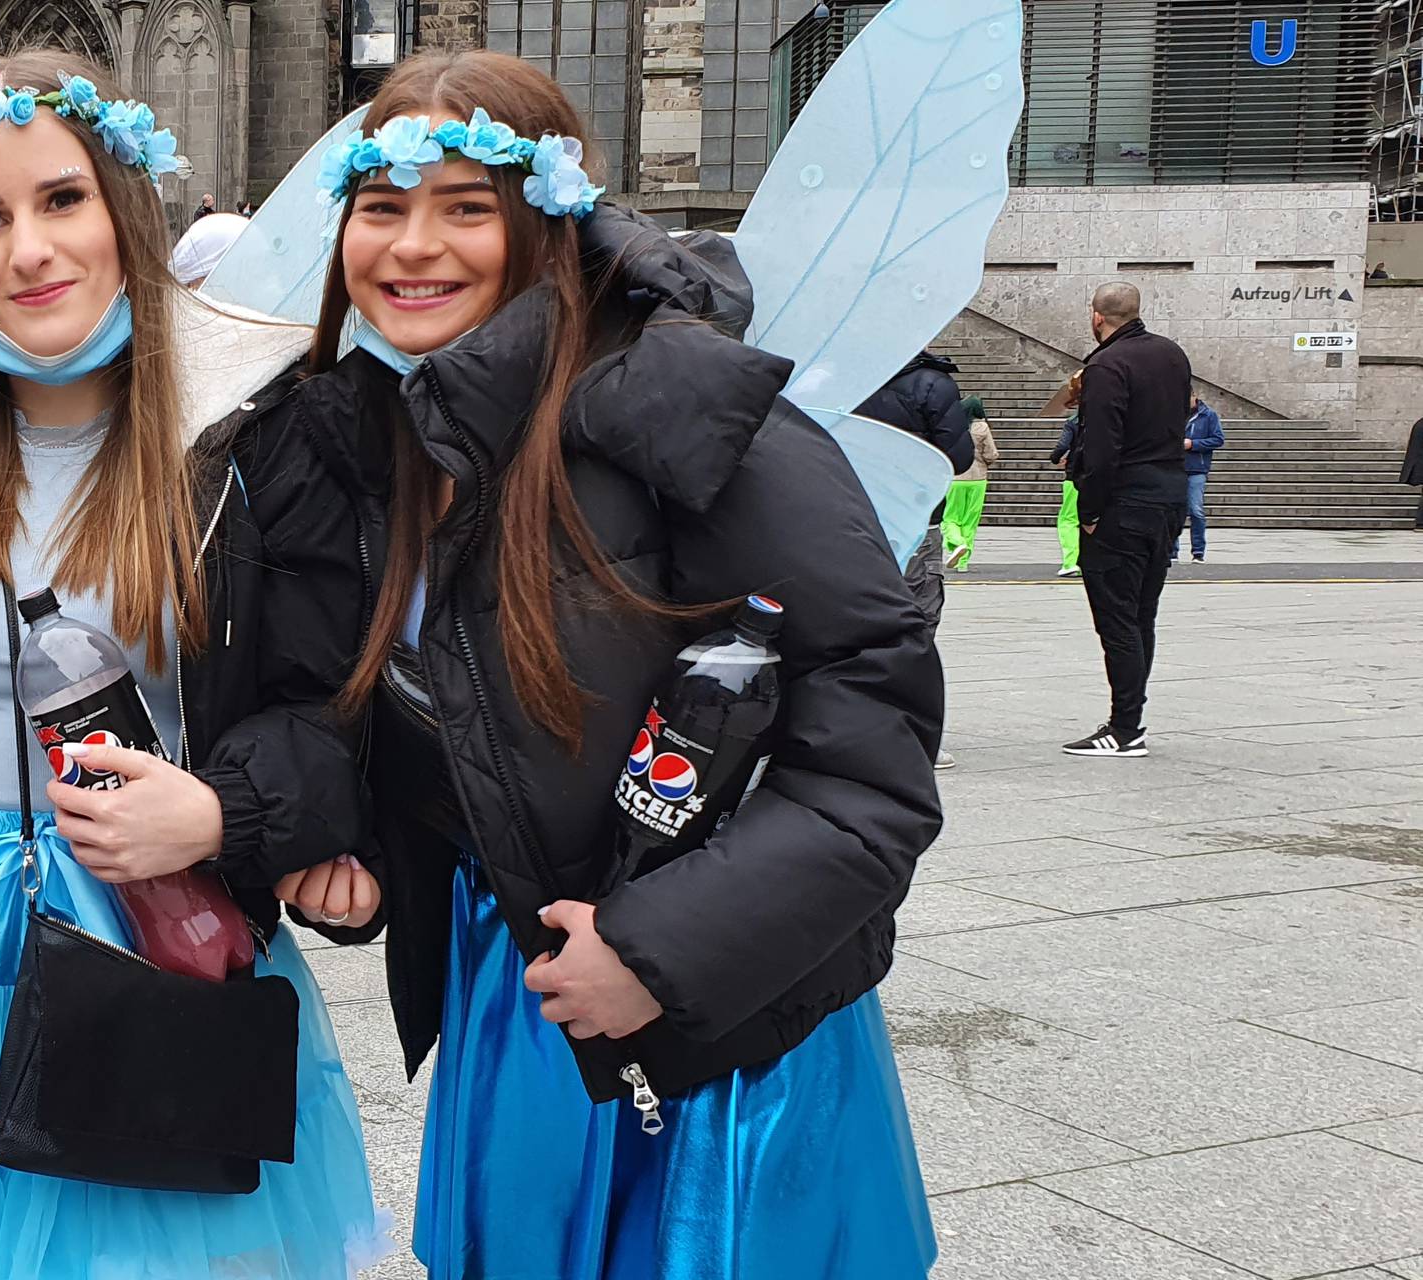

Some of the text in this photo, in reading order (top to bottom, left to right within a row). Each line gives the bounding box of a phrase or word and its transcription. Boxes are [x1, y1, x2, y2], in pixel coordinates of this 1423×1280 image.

[1251, 19, 1297, 65] U
[1230, 286, 1333, 303] Aufzug / Lift
[618, 770, 694, 829] CYCELT
[629, 807, 679, 838] FLASCHEN
